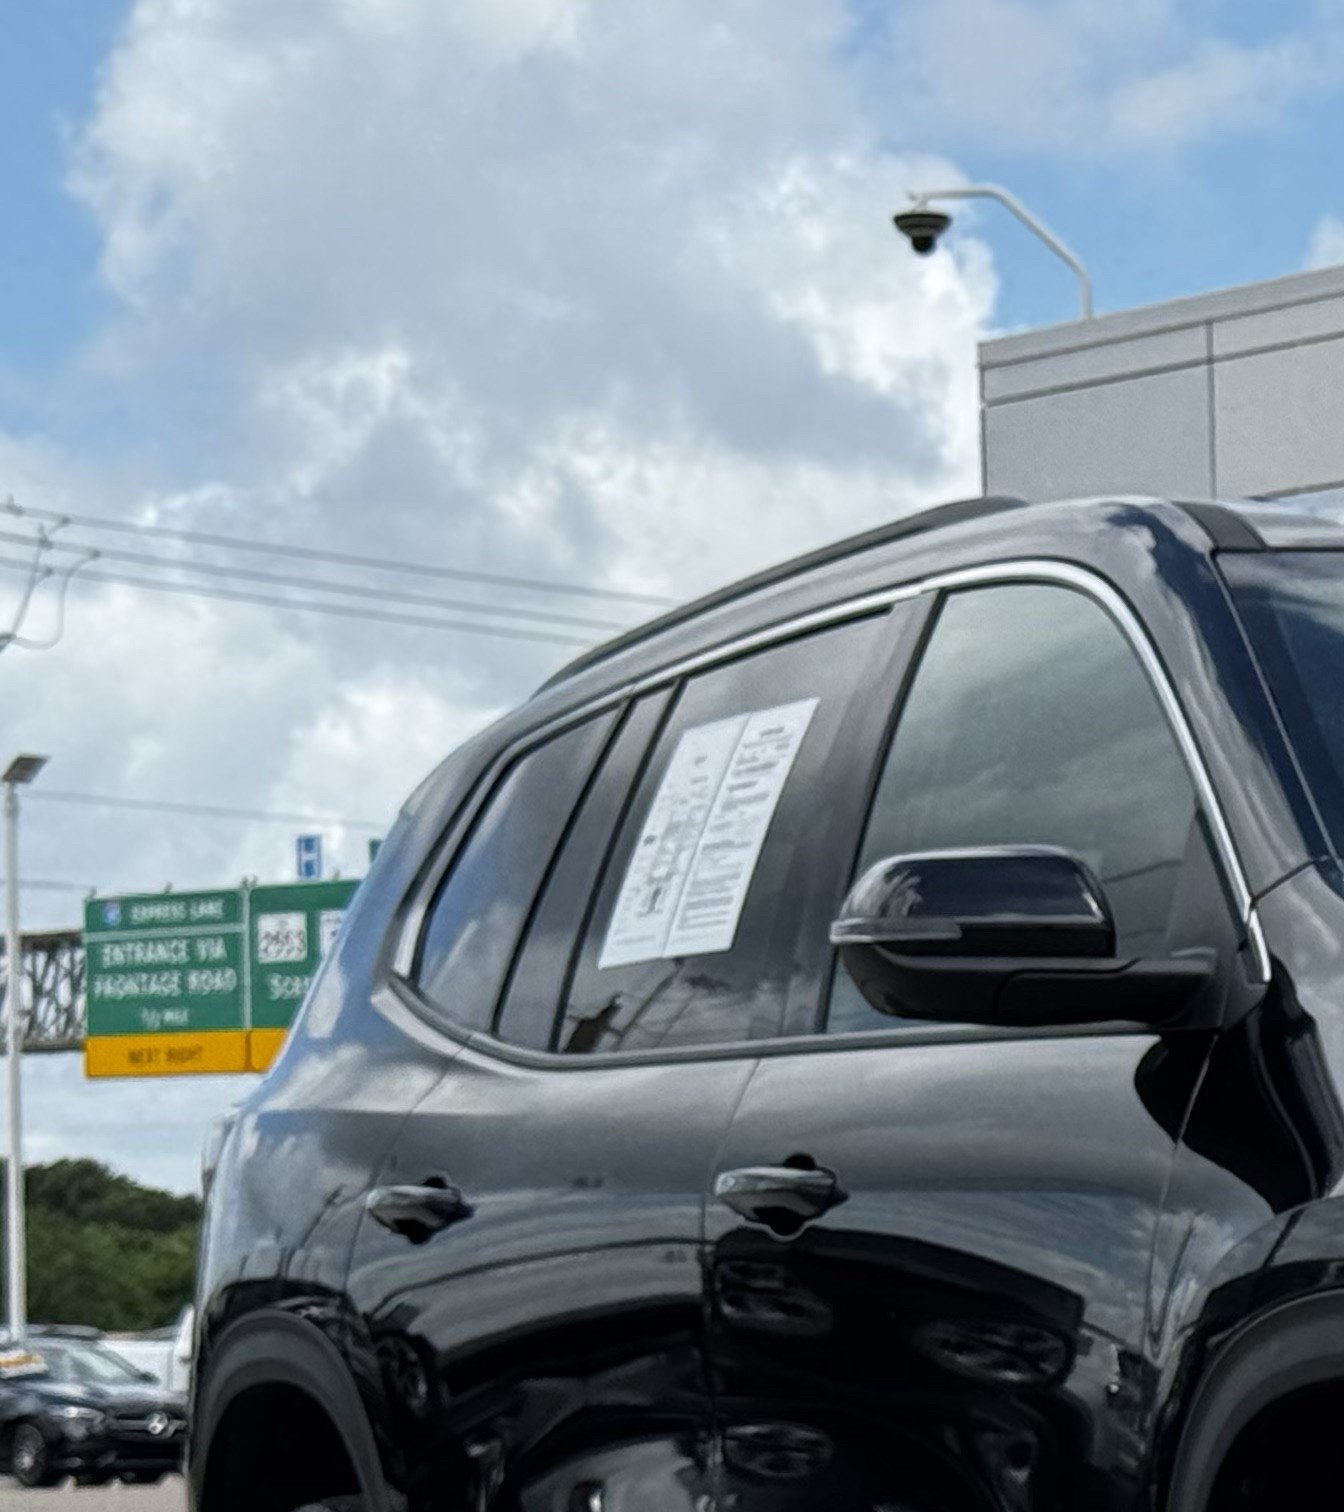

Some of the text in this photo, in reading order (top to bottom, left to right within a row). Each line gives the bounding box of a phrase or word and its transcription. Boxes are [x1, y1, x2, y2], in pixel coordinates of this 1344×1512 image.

[102, 936, 227, 969] ENTRANCE VIA
[94, 967, 238, 1001] FRONTAGE ROAD
